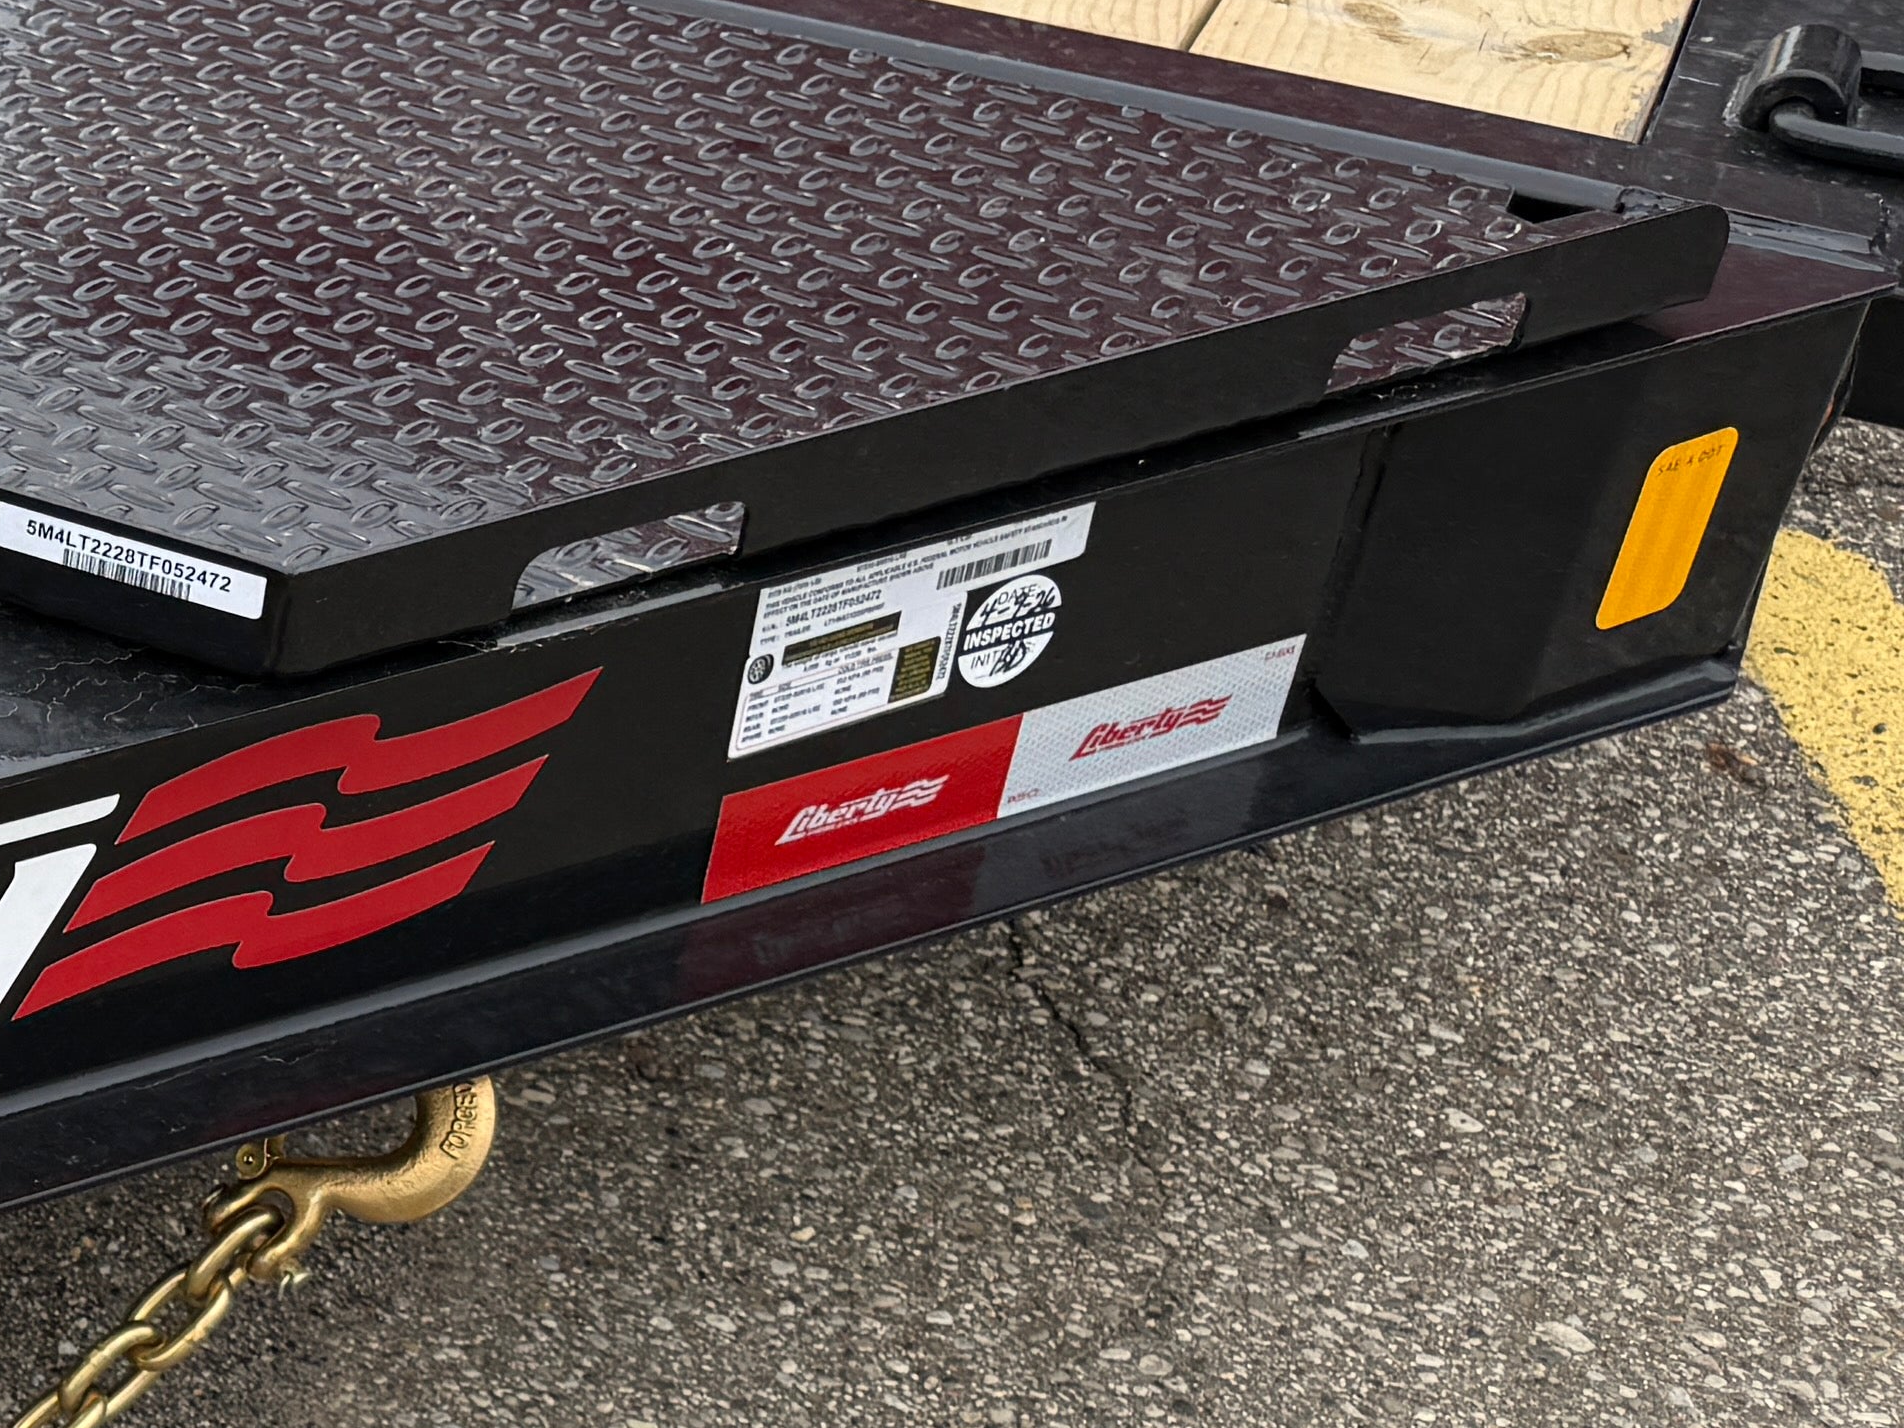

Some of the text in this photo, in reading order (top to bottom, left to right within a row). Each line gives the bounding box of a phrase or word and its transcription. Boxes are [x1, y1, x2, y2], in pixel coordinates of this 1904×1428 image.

[26, 519, 232, 593] 5M4LT2228TF052472
[963, 612, 1056, 651] INSPECTED
[1068, 705, 1187, 762] Liberty
[774, 787, 902, 846] Liberty
[440, 1080, 478, 1160] FORGED
